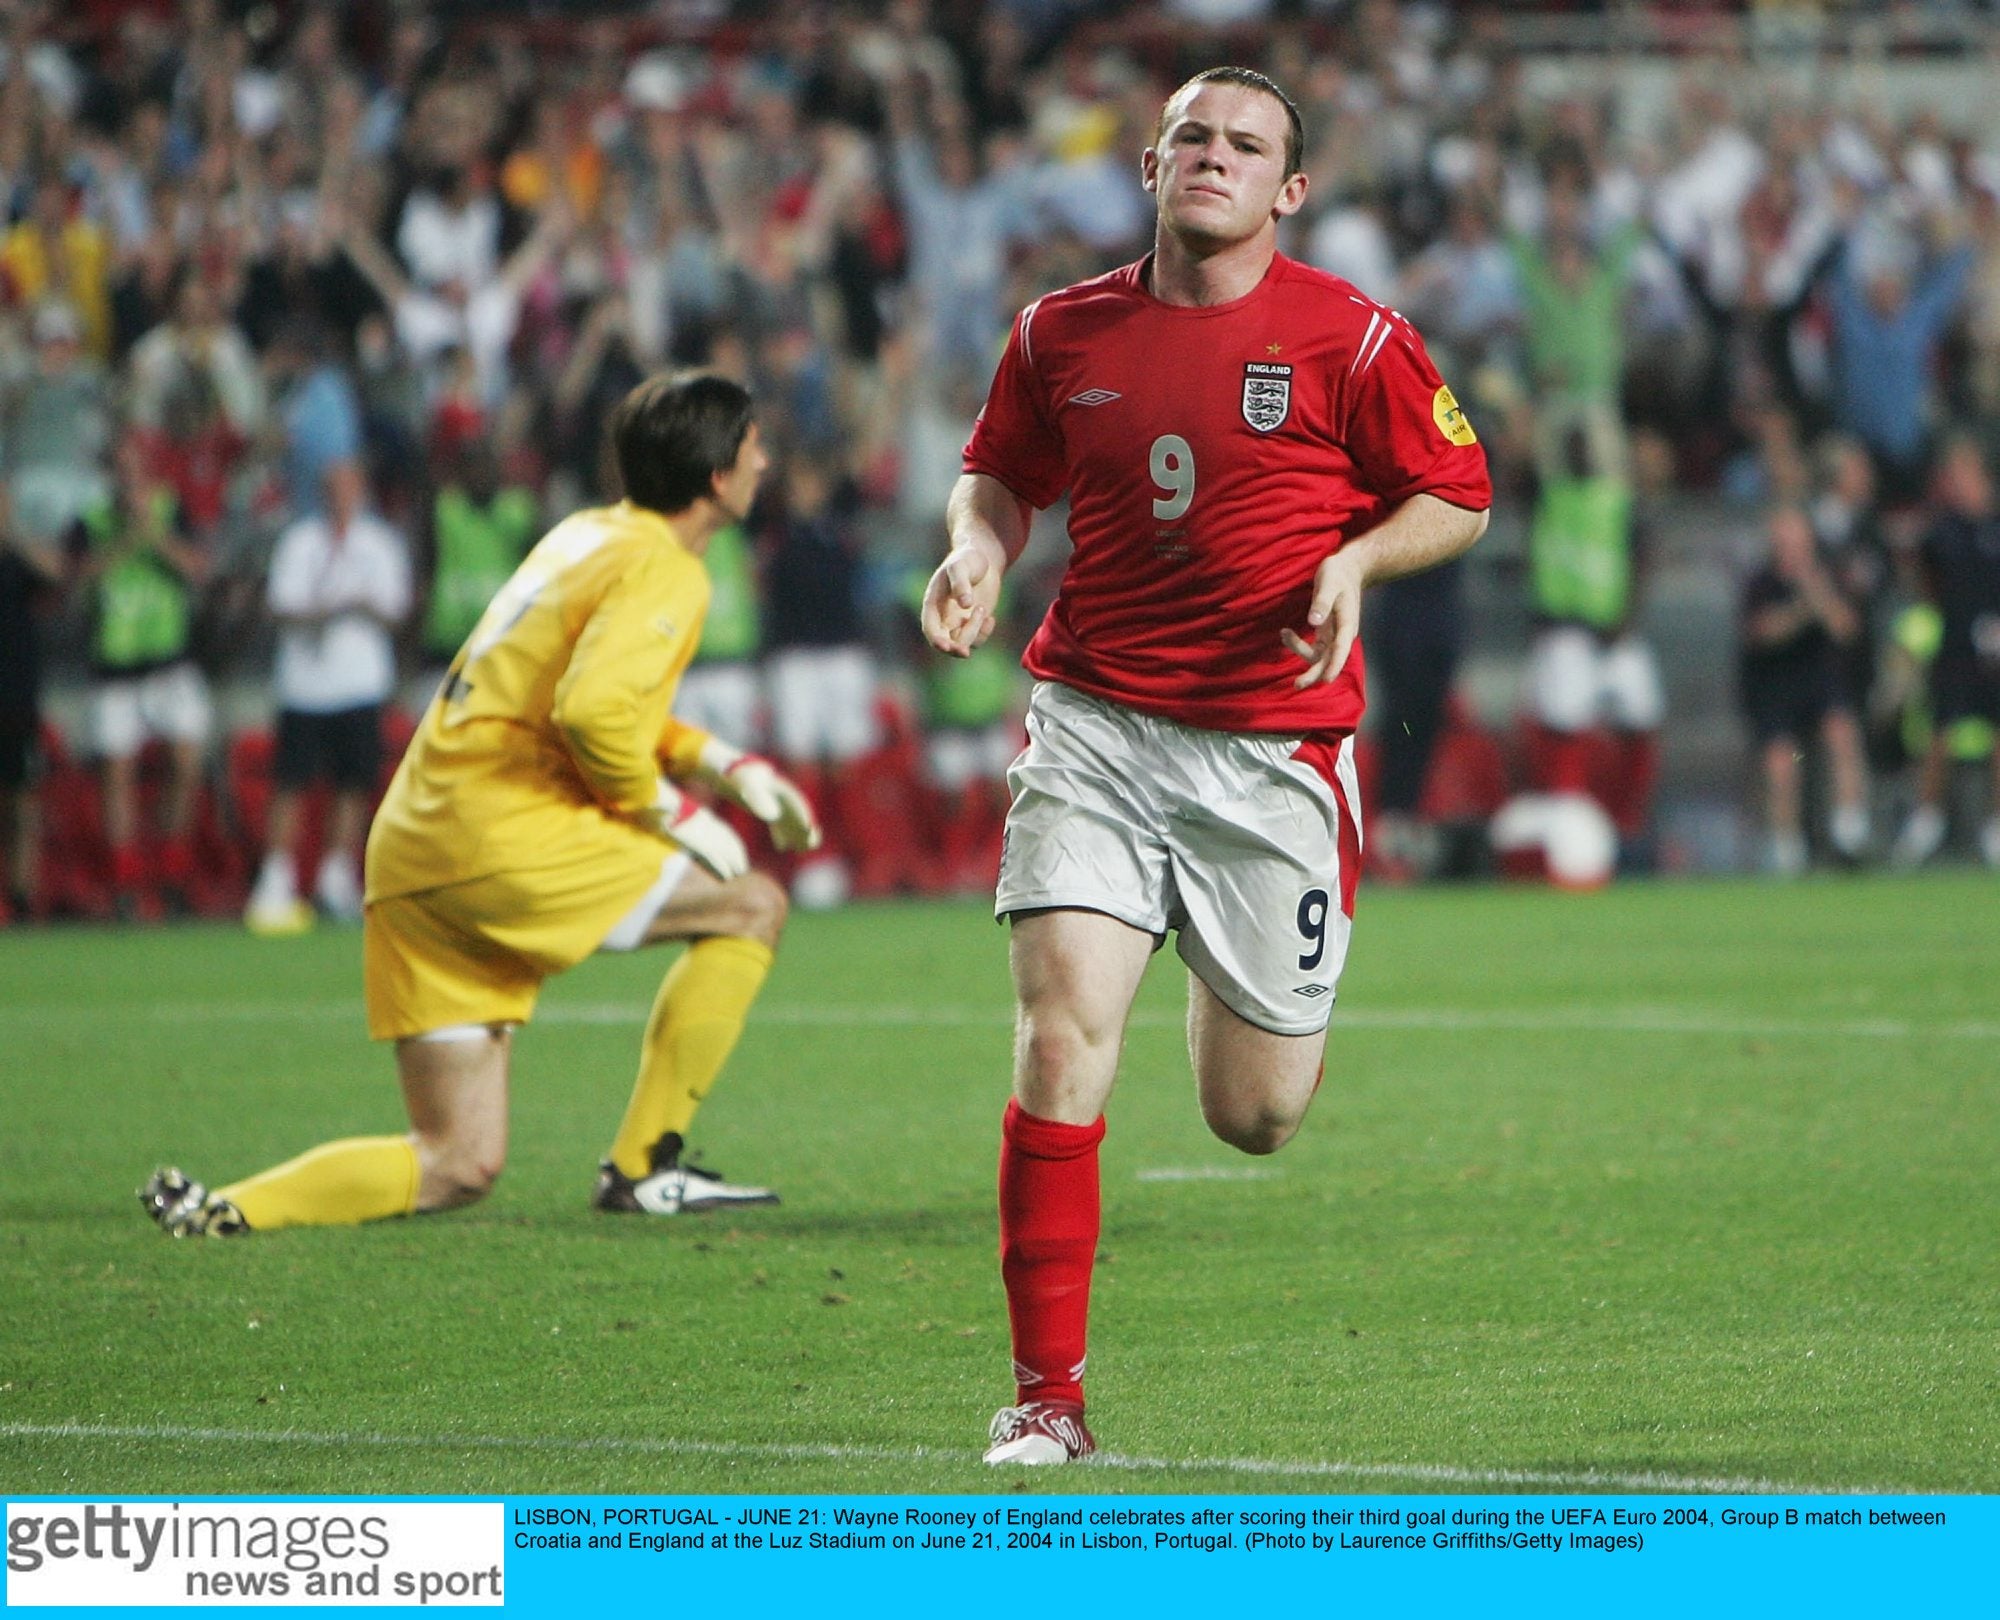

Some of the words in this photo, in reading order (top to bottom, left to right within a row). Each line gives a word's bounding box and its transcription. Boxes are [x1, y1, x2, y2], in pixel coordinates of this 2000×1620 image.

[1246, 363, 1291, 375] ENGLAND
[1149, 433, 1196, 521] 9
[1296, 888, 1329, 972] 9
